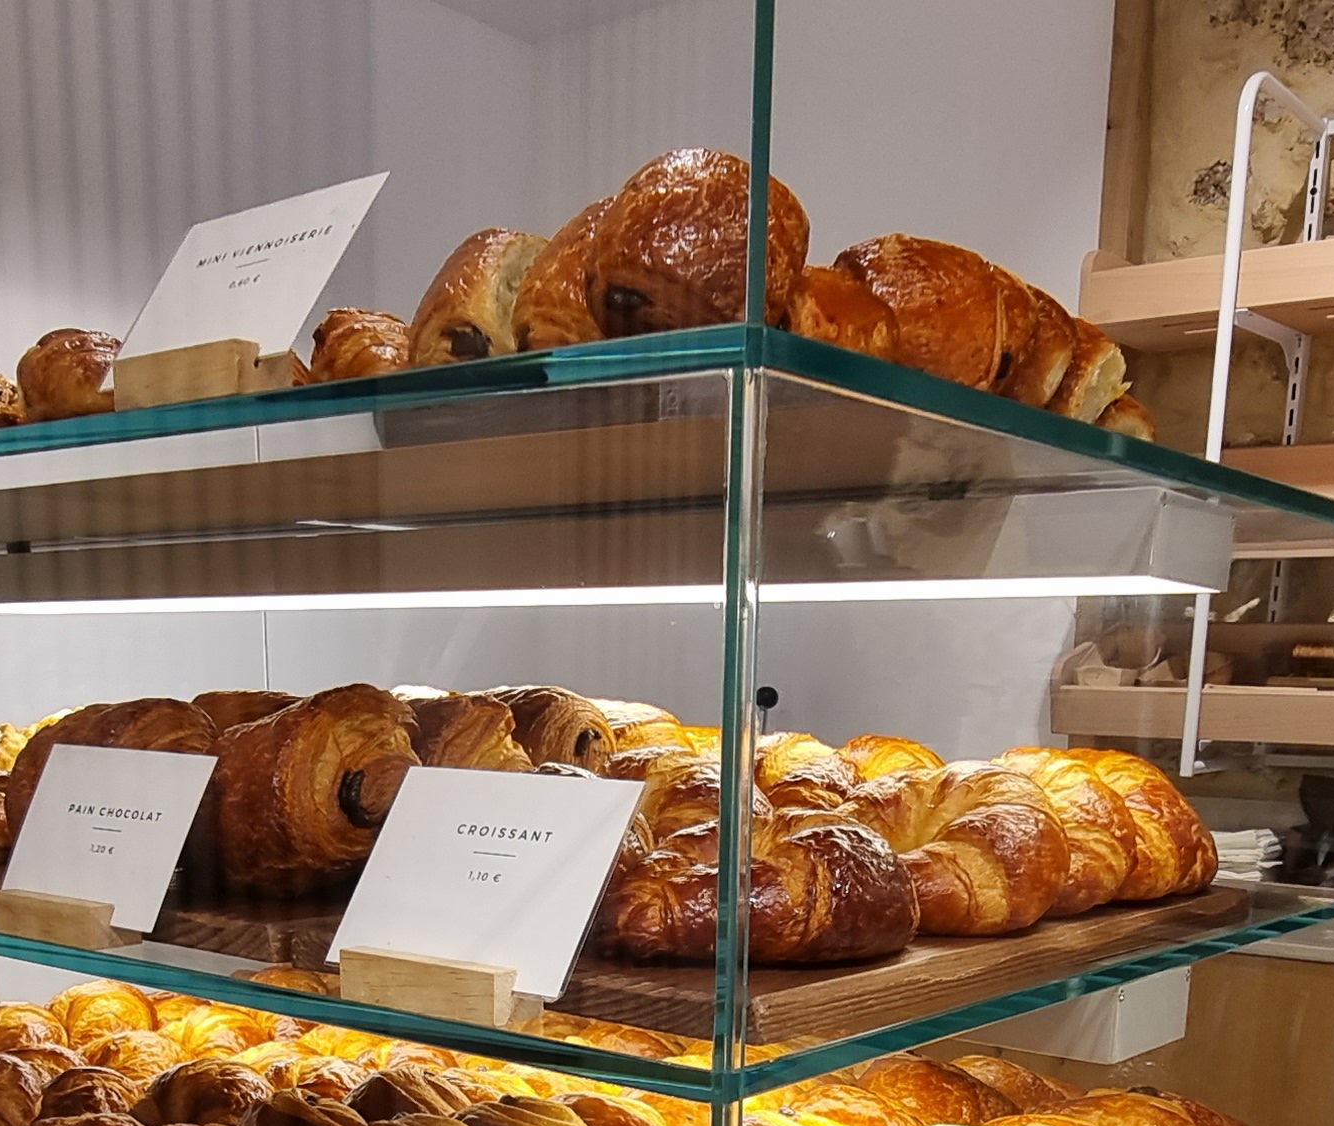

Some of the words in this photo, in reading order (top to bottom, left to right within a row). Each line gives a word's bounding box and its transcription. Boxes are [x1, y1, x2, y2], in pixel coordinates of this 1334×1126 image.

[196, 254, 228, 268] MINI
[232, 225, 333, 258] VIENNOISERIE
[68, 804, 96, 815] PAIN
[99, 807, 162, 821] CHOCOLAT
[457, 824, 553, 842] CROISSANT
[468, 870, 489, 882] 1,10
[493, 873, 502, 882] €
